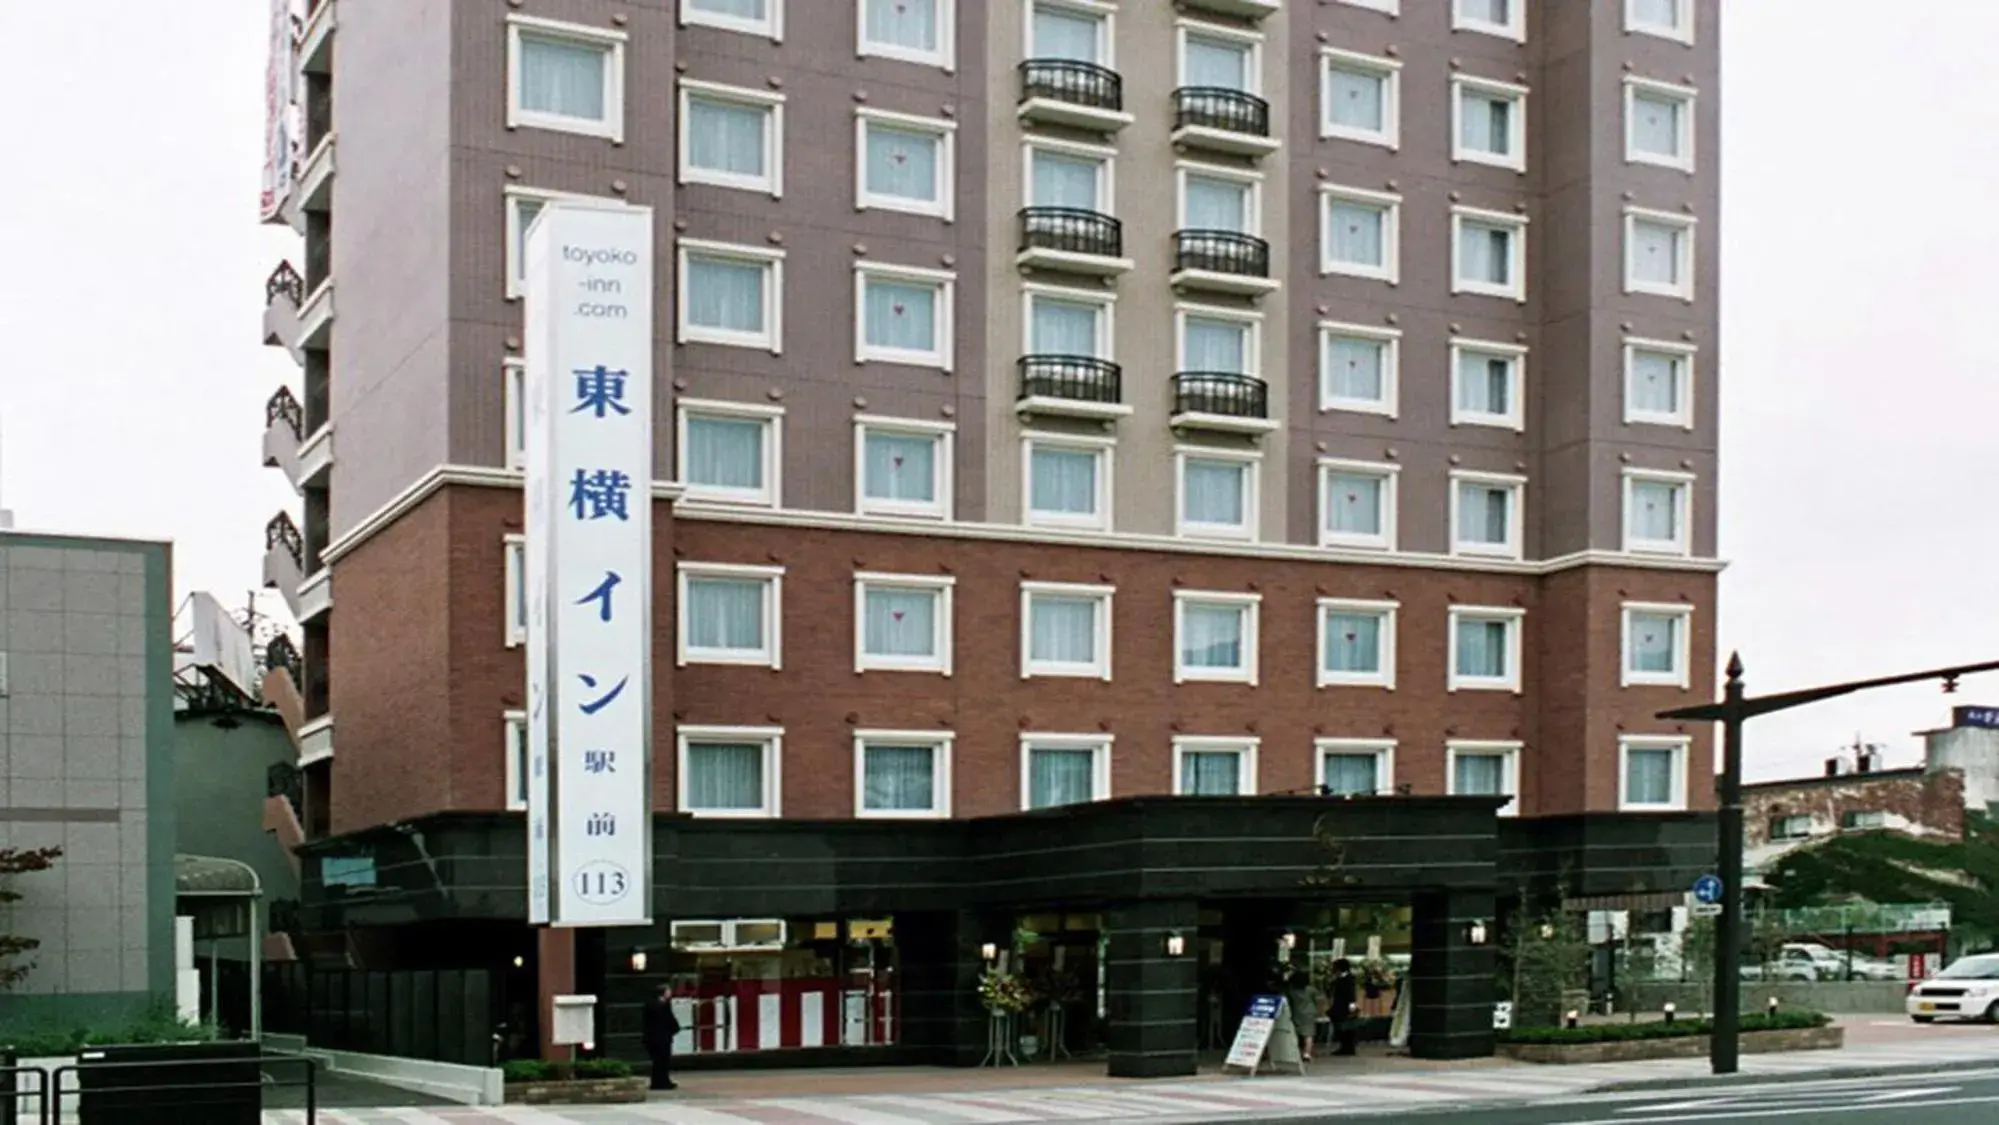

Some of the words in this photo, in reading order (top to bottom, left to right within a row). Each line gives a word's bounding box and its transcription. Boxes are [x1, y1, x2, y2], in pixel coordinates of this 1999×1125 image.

[562, 245, 638, 267] toyoko
[578, 276, 622, 295] -inn
[573, 302, 629, 319] .com
[580, 872, 625, 895] 113
